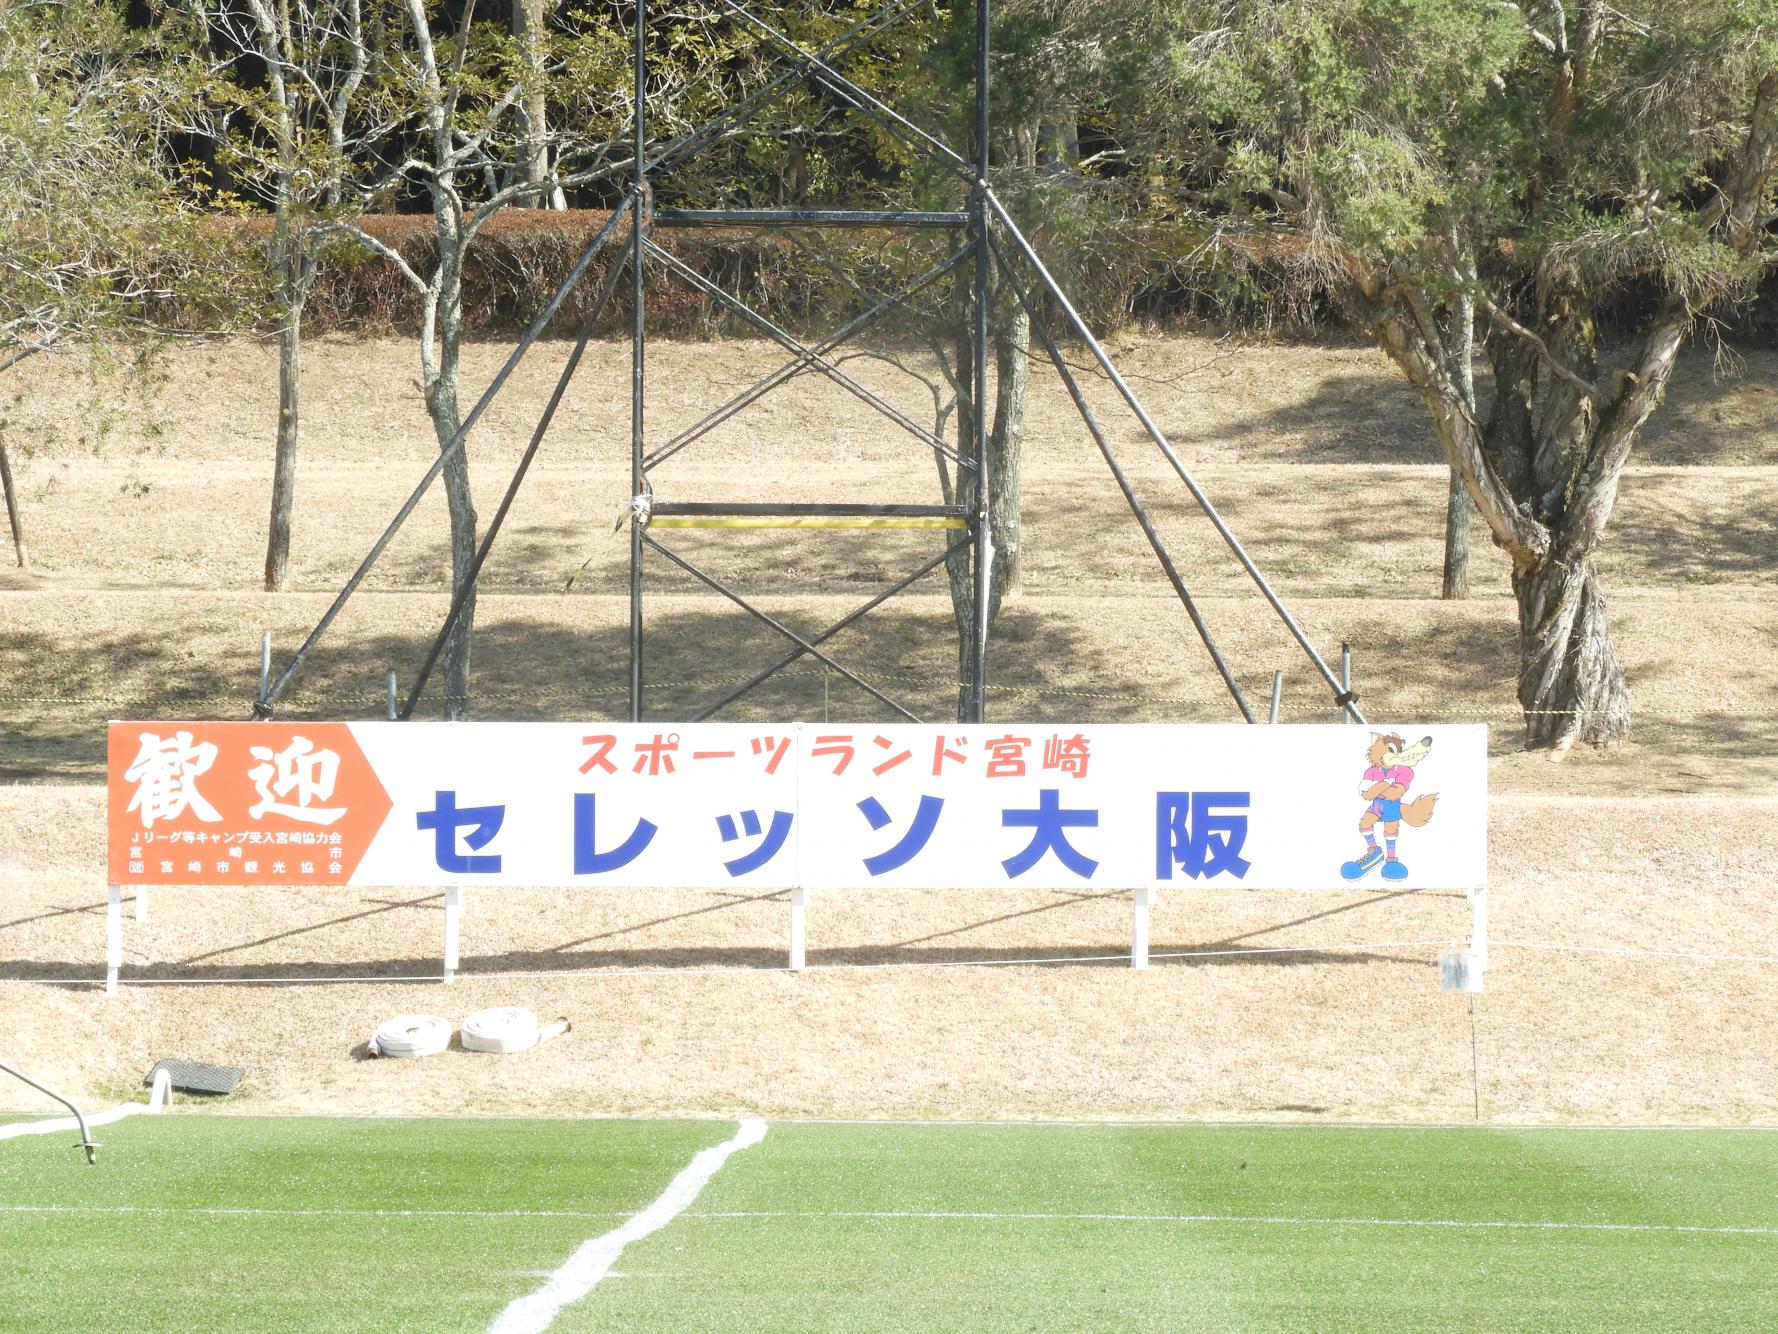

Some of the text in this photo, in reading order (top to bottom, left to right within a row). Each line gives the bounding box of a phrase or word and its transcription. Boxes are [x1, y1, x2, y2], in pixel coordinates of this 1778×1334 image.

[125, 731, 348, 828] 歓迎
[579, 734, 1089, 778] スポーツランド宮崎
[416, 790, 1250, 880] セレッソ大阪
